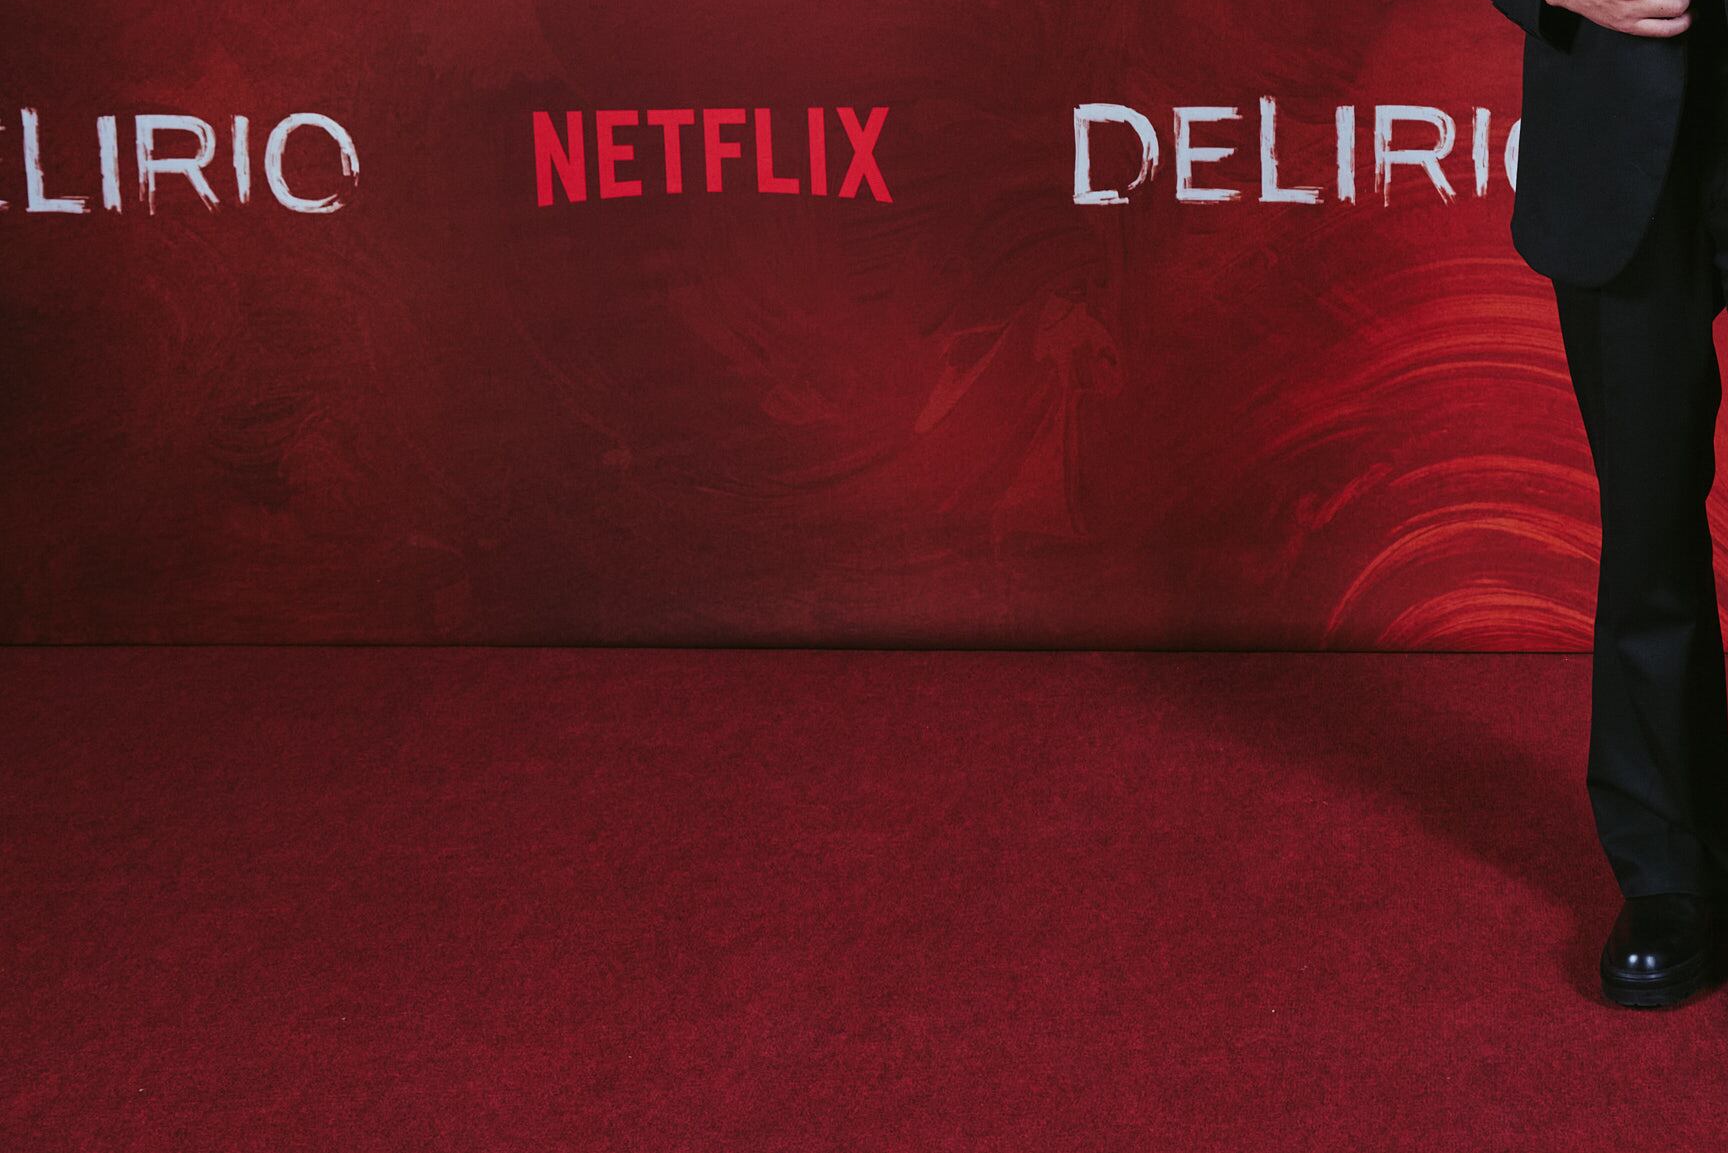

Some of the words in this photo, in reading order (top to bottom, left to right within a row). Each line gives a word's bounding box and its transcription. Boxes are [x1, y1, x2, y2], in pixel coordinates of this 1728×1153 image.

[0, 106, 361, 216] LIRIO
[532, 106, 893, 207] NETFLIX
[1072, 94, 1522, 209] DELIRI
